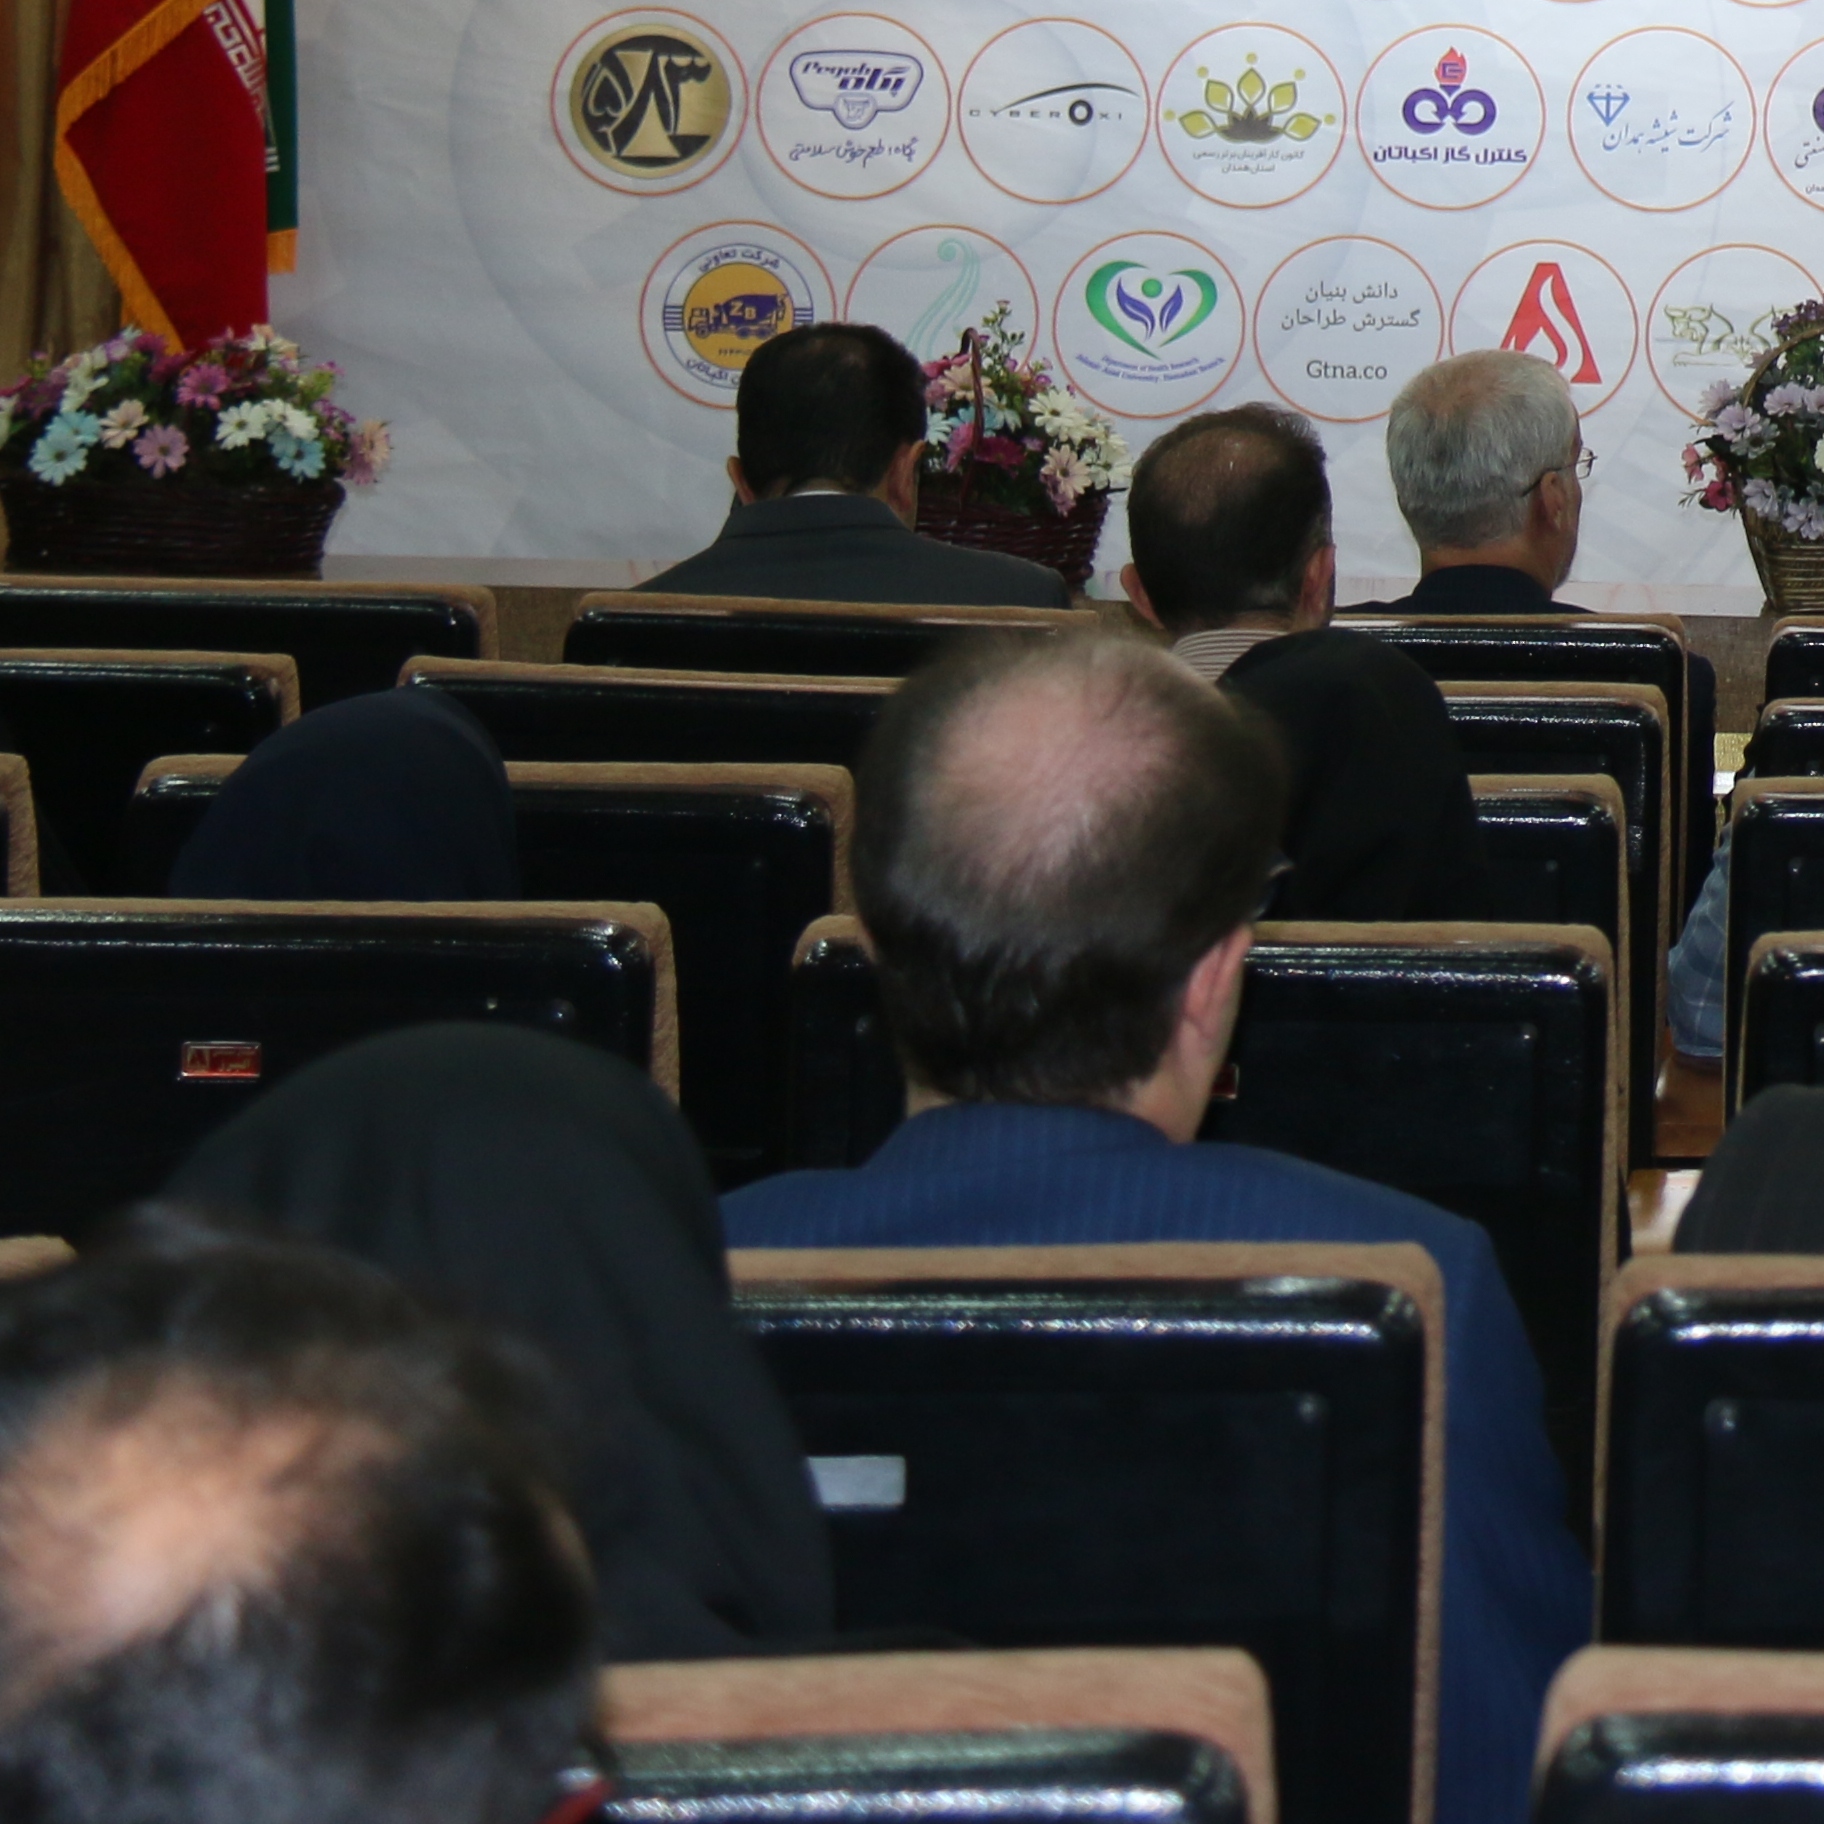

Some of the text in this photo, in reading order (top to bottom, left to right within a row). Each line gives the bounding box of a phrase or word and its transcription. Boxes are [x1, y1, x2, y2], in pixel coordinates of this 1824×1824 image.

[1677, 100, 1735, 154] شرکت
[1372, 144, 1528, 165] کنترل گاز اکباتان
[698, 248, 781, 273] شرکت تعاونی
[1304, 280, 1400, 304] دانش بنیان
[1280, 308, 1422, 332] گسترش طراحان
[1305, 359, 1388, 381] Gtna.co
